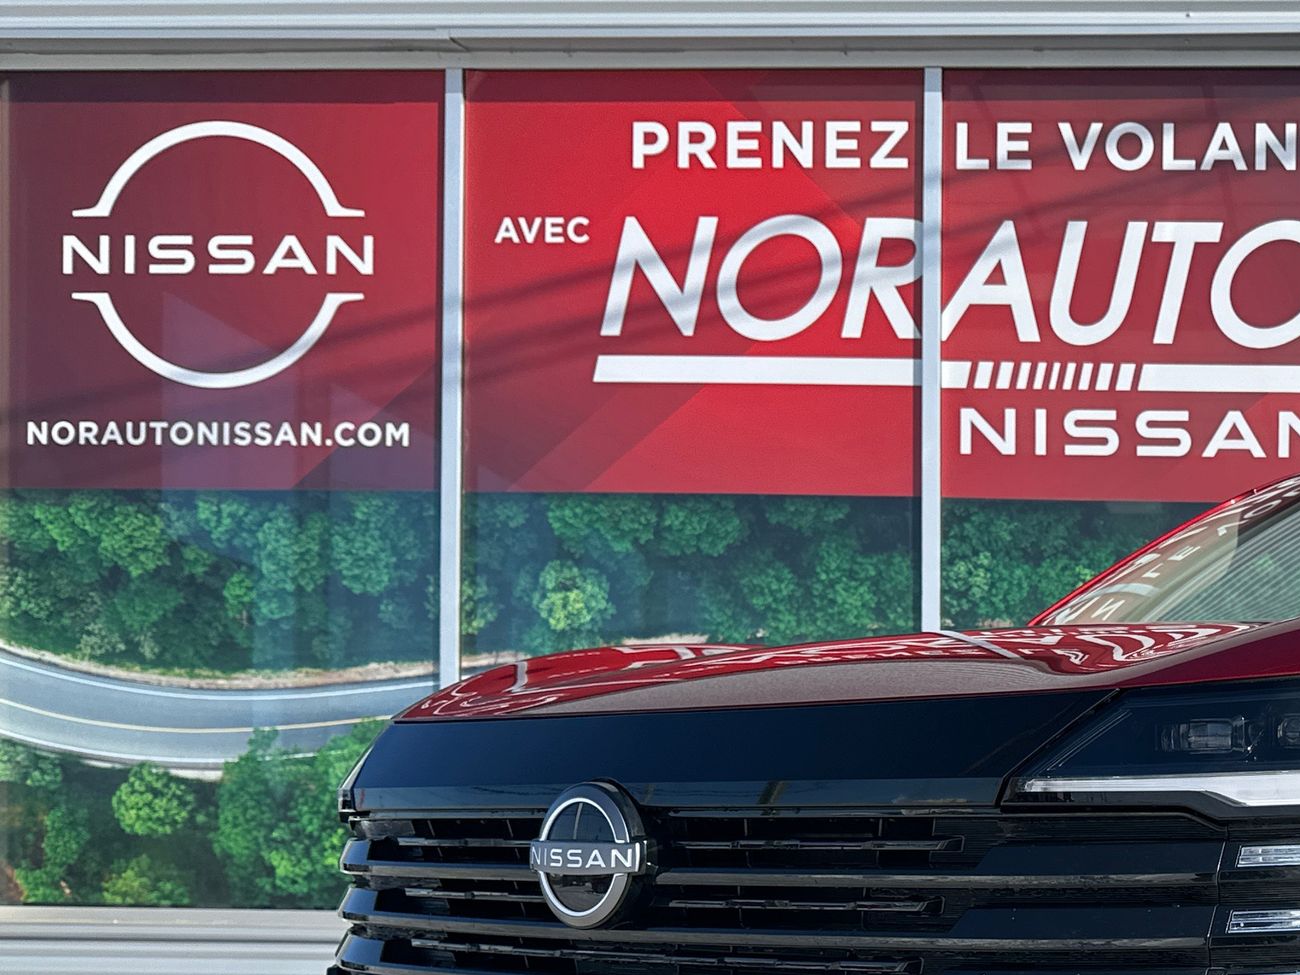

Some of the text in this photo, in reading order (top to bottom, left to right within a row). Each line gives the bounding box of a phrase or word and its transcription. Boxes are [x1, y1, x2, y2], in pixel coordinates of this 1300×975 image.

[632, 120, 910, 169] PRENEZ
[956, 122, 1033, 171] LE
[494, 216, 590, 244] AVEC
[62, 234, 374, 275] NISSAN
[27, 420, 410, 447] NORAUTONISSAN.COM
[531, 846, 633, 868] NISSAN
